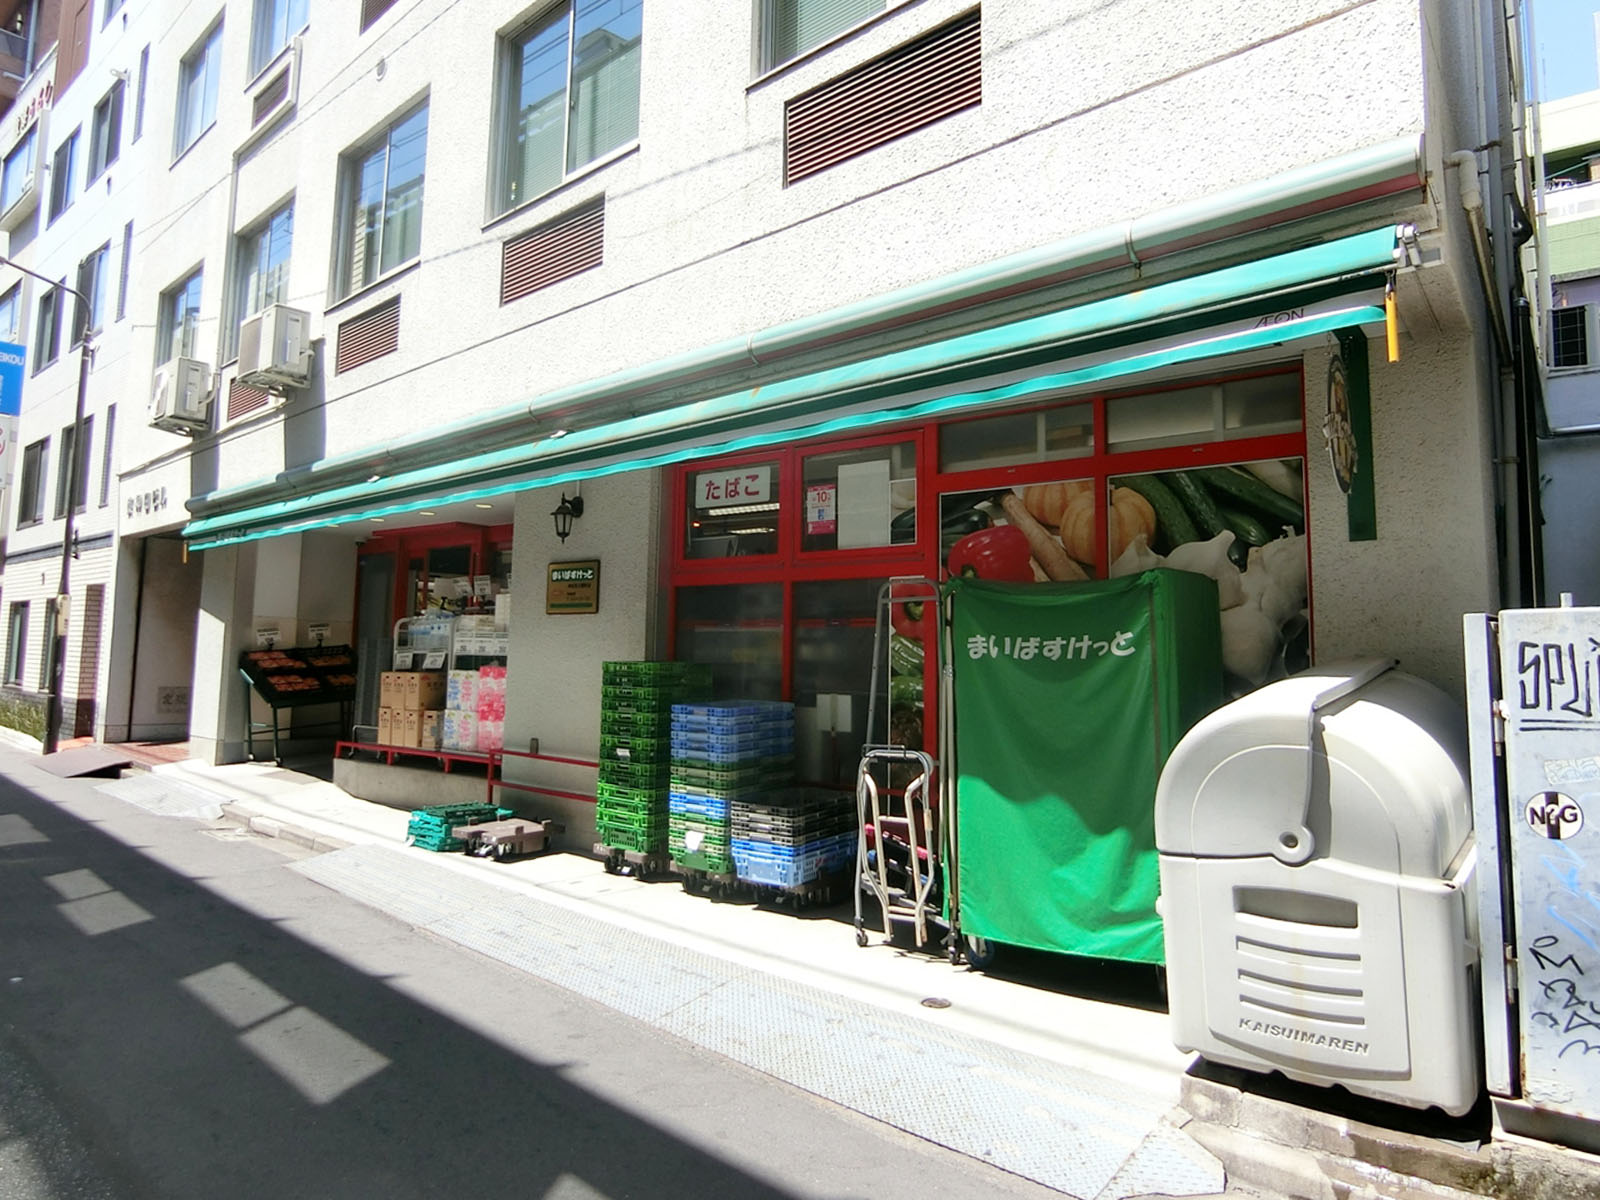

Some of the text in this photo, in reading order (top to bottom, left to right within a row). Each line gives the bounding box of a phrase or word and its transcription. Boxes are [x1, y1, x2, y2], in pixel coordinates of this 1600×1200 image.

[706, 474, 760, 500] たばこ
[967, 631, 1136, 661] まいばすけっと
[1239, 1018, 1369, 1054] KAISUIMAREN
